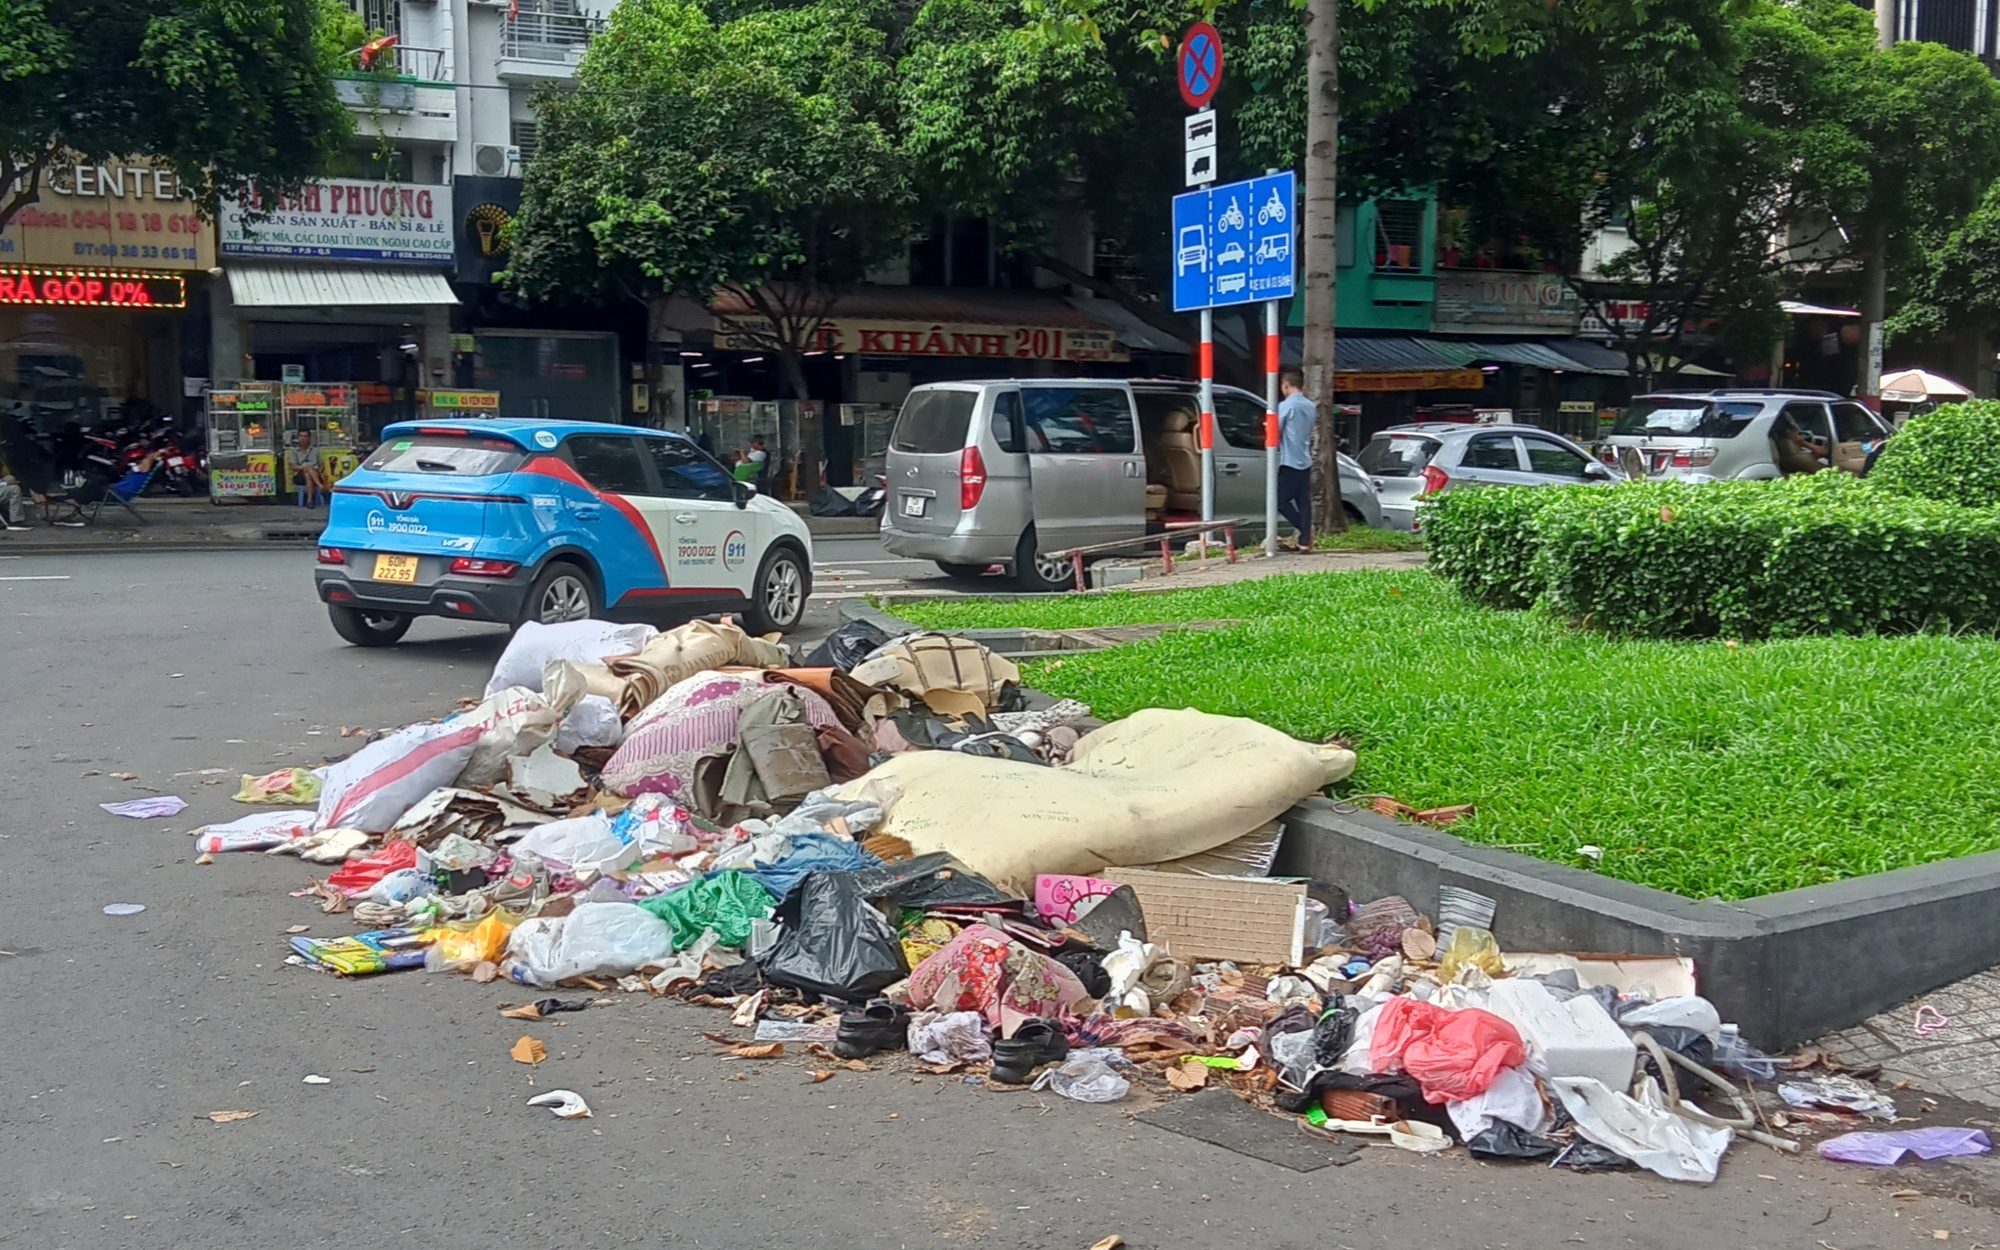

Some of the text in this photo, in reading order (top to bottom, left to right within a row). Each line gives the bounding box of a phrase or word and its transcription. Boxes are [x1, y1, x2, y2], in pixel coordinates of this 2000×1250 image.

[71, 209, 110, 231] 094
[116, 212, 138, 231] 18
[141, 213, 162, 233] 18
[167, 213, 202, 234] 618
[320, 214, 358, 229] XUẤT
[369, 217, 397, 231] BÁN
[415, 222, 426, 233] &
[225, 243, 240, 251] 197
[226, 230, 241, 241] XE
[294, 230, 315, 244] CÁC
[317, 234, 340, 246] LOẠI
[356, 236, 380, 247] INOX
[412, 238, 431, 250] CAO
[433, 237, 451, 250] CẤP
[121, 244, 138, 258] 38
[141, 245, 158, 258] 33
[181, 247, 197, 261] 18
[42, 274, 104, 301] GÓP
[110, 281, 149, 304] 0%
[858, 325, 1010, 357] KHÁNH
[1015, 328, 1062, 358] 201
[371, 517, 385, 526] 911
[388, 522, 408, 533] 1900
[408, 524, 428, 534] 0122
[678, 545, 717, 557] 1900 0122
[728, 543, 746, 557] 911
[387, 555, 407, 567] 60H
